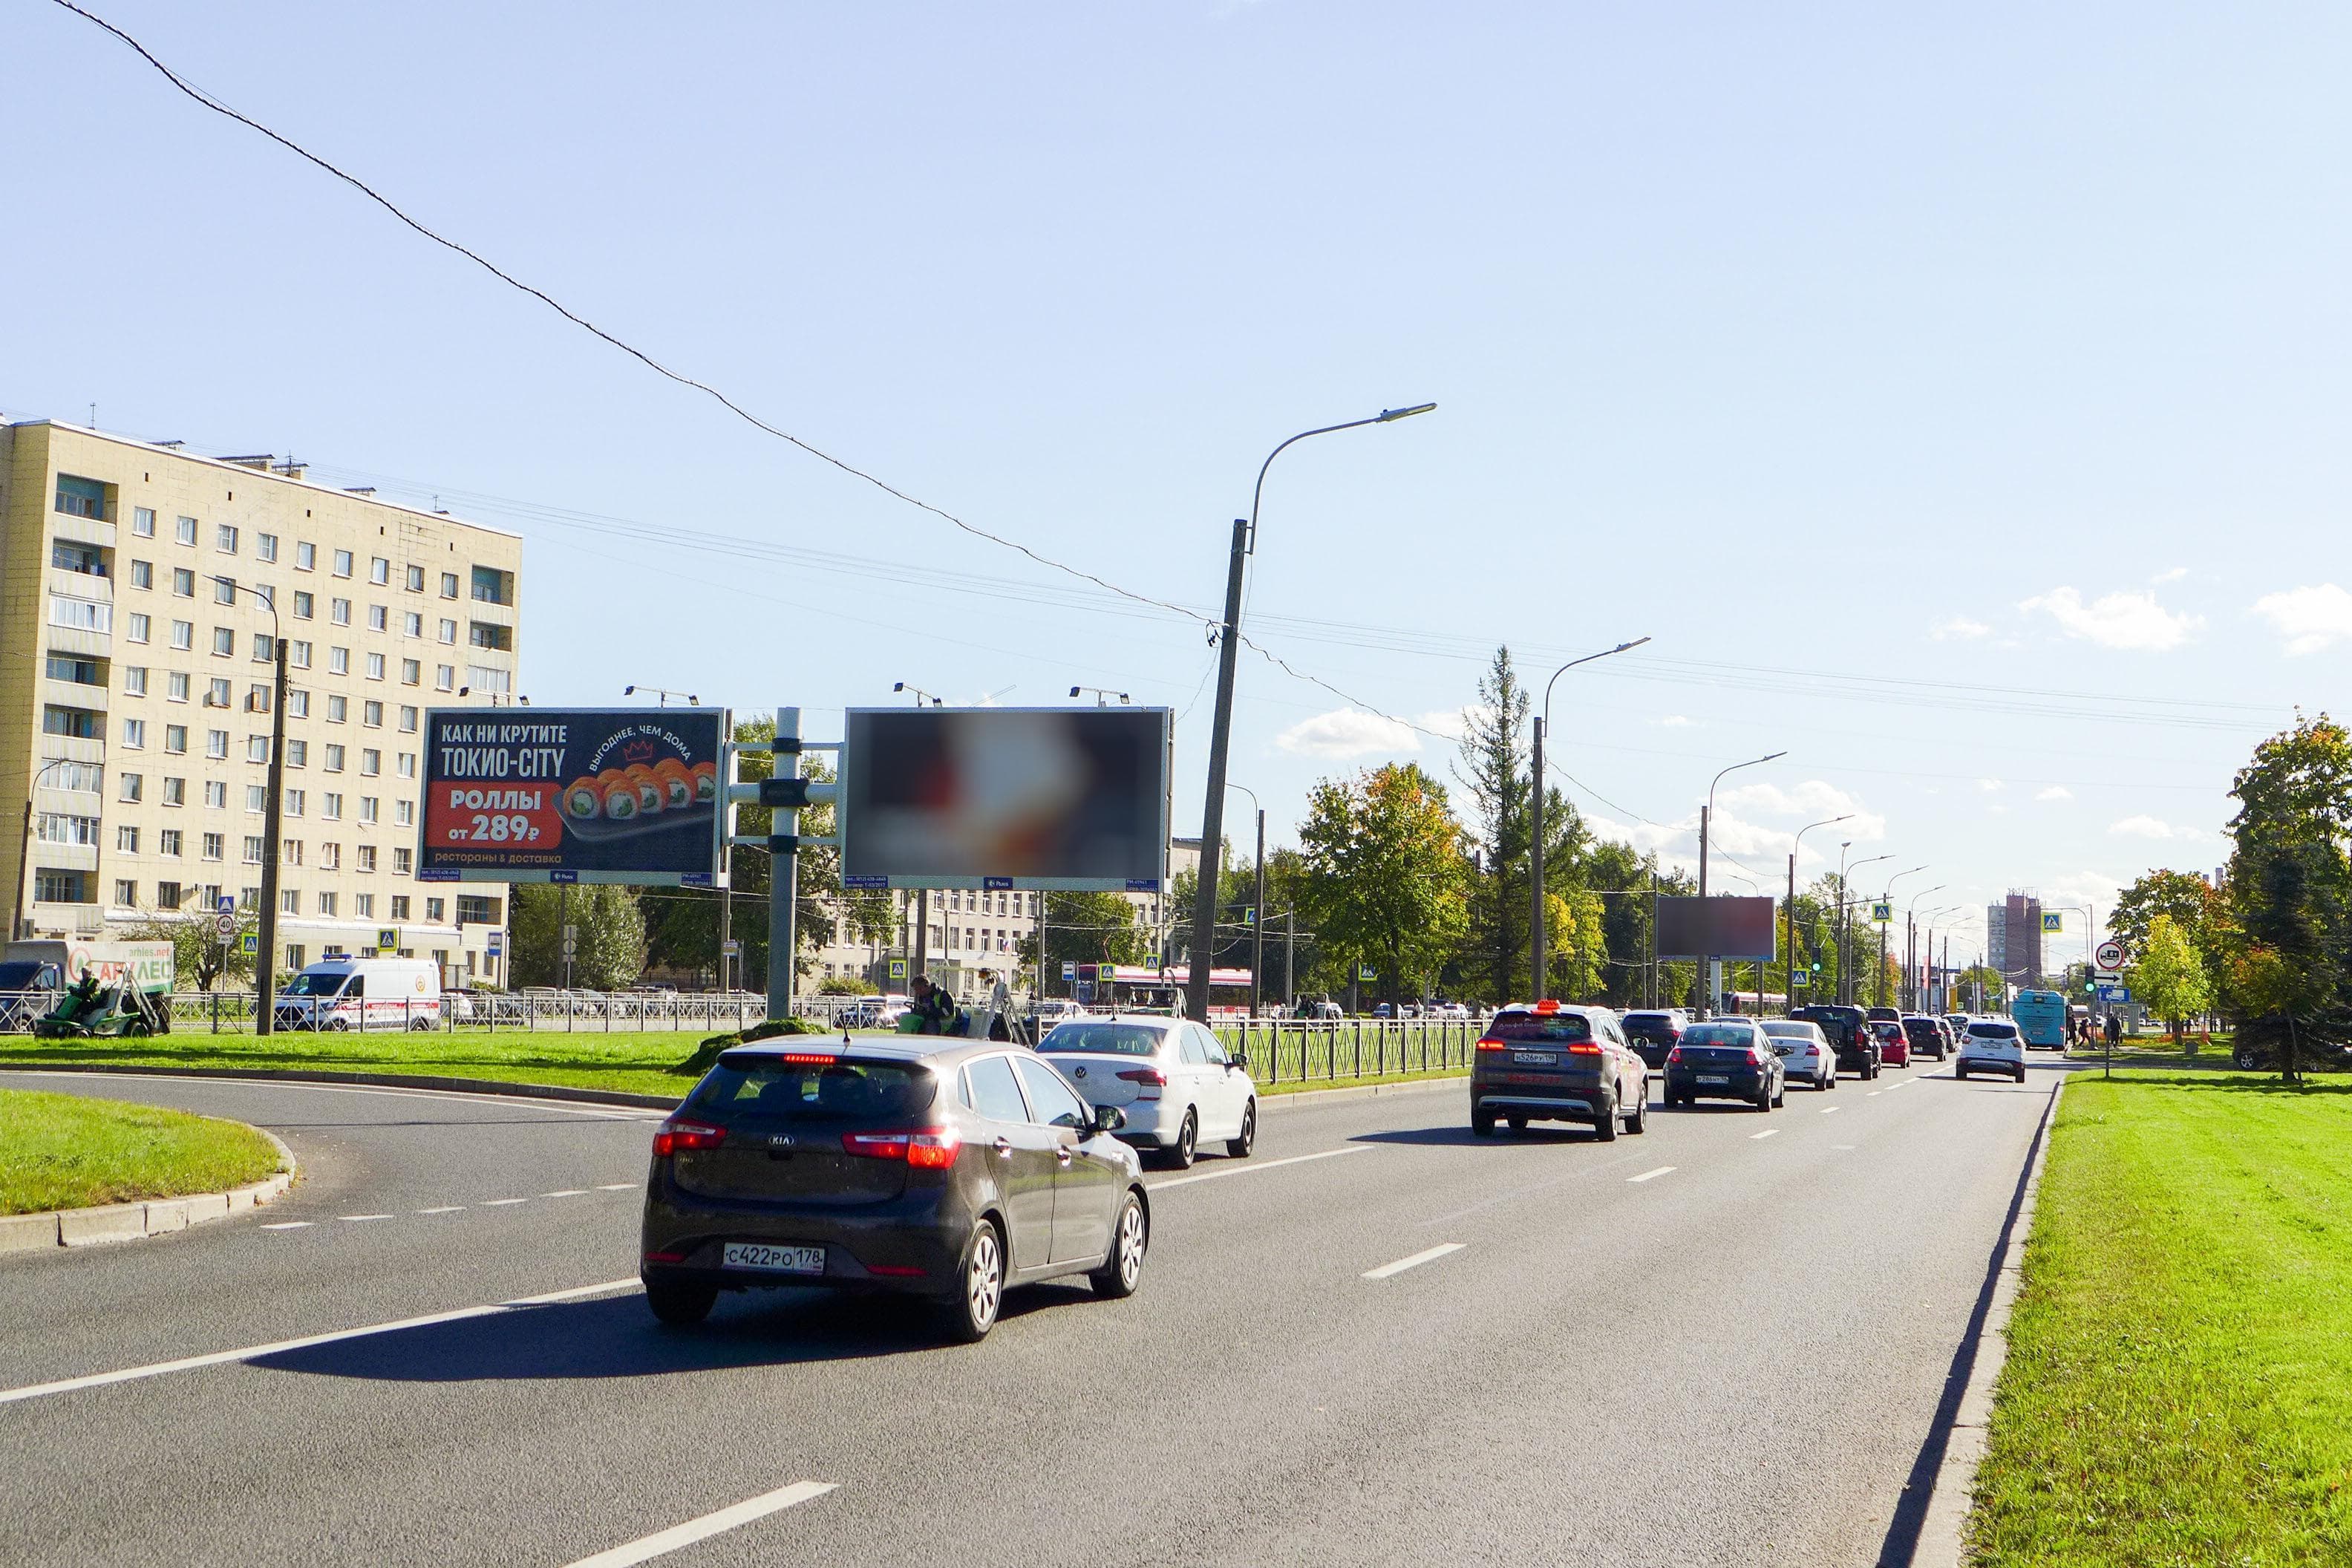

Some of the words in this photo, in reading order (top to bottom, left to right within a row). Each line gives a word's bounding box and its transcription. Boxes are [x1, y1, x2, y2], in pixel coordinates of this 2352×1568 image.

[442, 725, 473, 742] КАК
[477, 725, 497, 742] НИ
[500, 725, 567, 743] КРУТИТЕ
[589, 727, 636, 772] ВЫГОДНЕЕ,
[639, 725, 662, 736] ЧЕМ
[663, 731, 691, 761] ДОМА
[441, 747, 566, 777] ТОКИО-CITY
[450, 789, 541, 810] РОЛЛЫ
[448, 828, 468, 840] от
[434, 853, 497, 863] рестораны
[500, 854, 506, 862] &
[509, 854, 562, 863] доставка
[129, 947, 171, 957] arhles.net
[771, 1136, 791, 1146] KIA
[796, 1249, 820, 1263] 178
